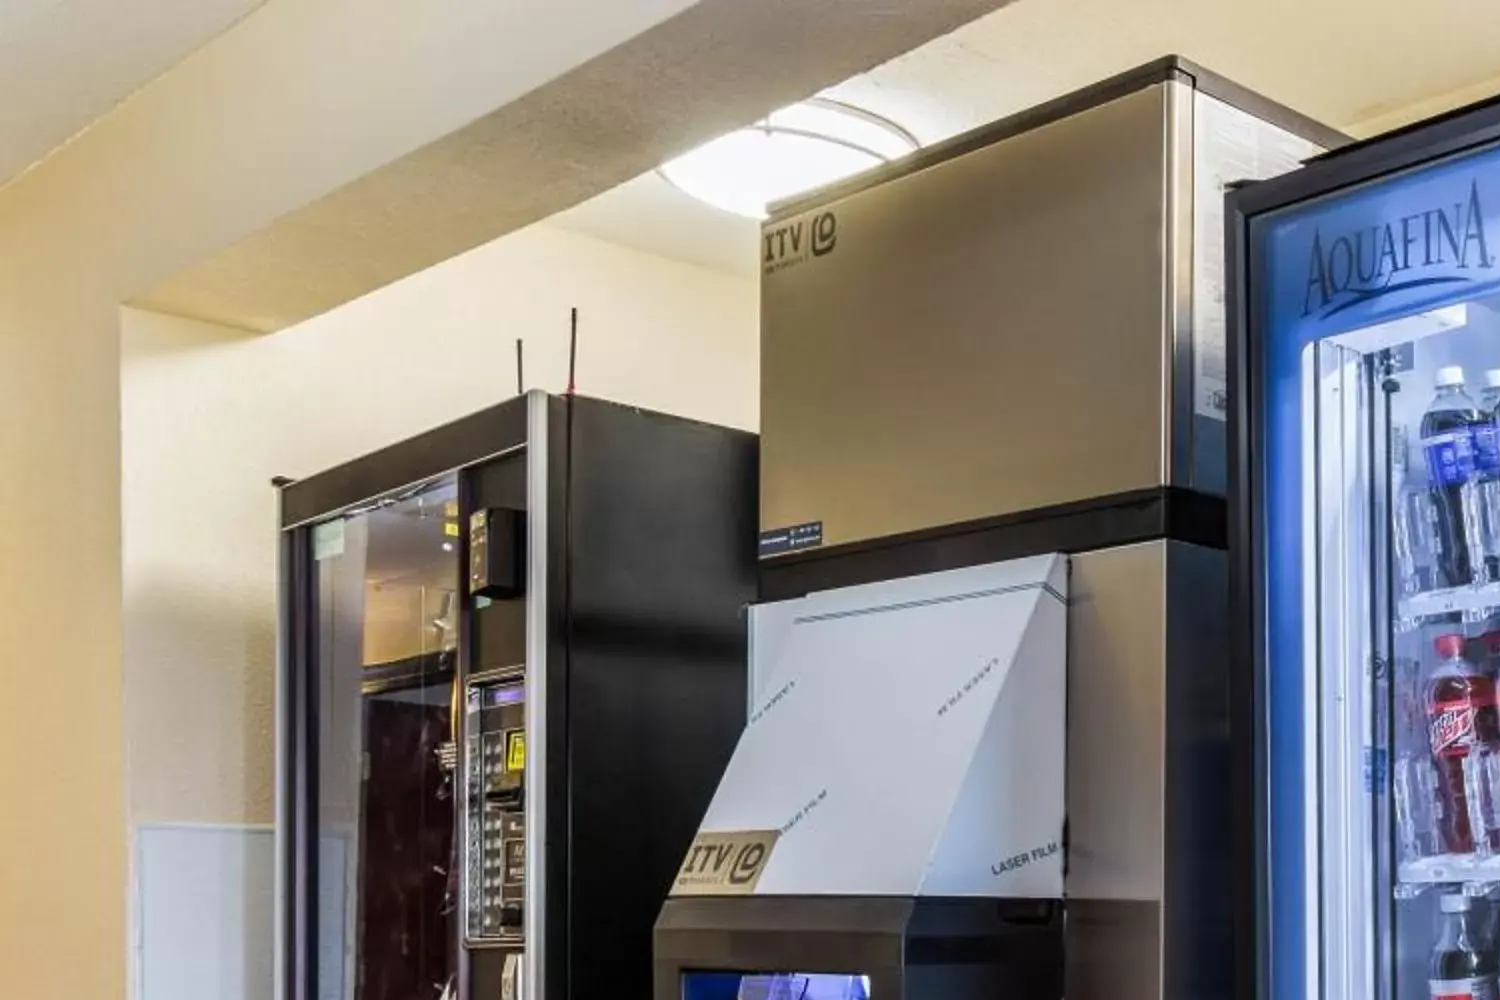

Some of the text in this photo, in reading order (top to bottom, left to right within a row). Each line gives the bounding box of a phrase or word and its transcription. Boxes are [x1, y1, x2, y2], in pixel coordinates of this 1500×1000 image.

[764, 221, 802, 262] ITV
[1300, 178, 1494, 318] AQUAFINA
[684, 842, 734, 873] ITV
[991, 841, 1058, 877] LASER FILM
